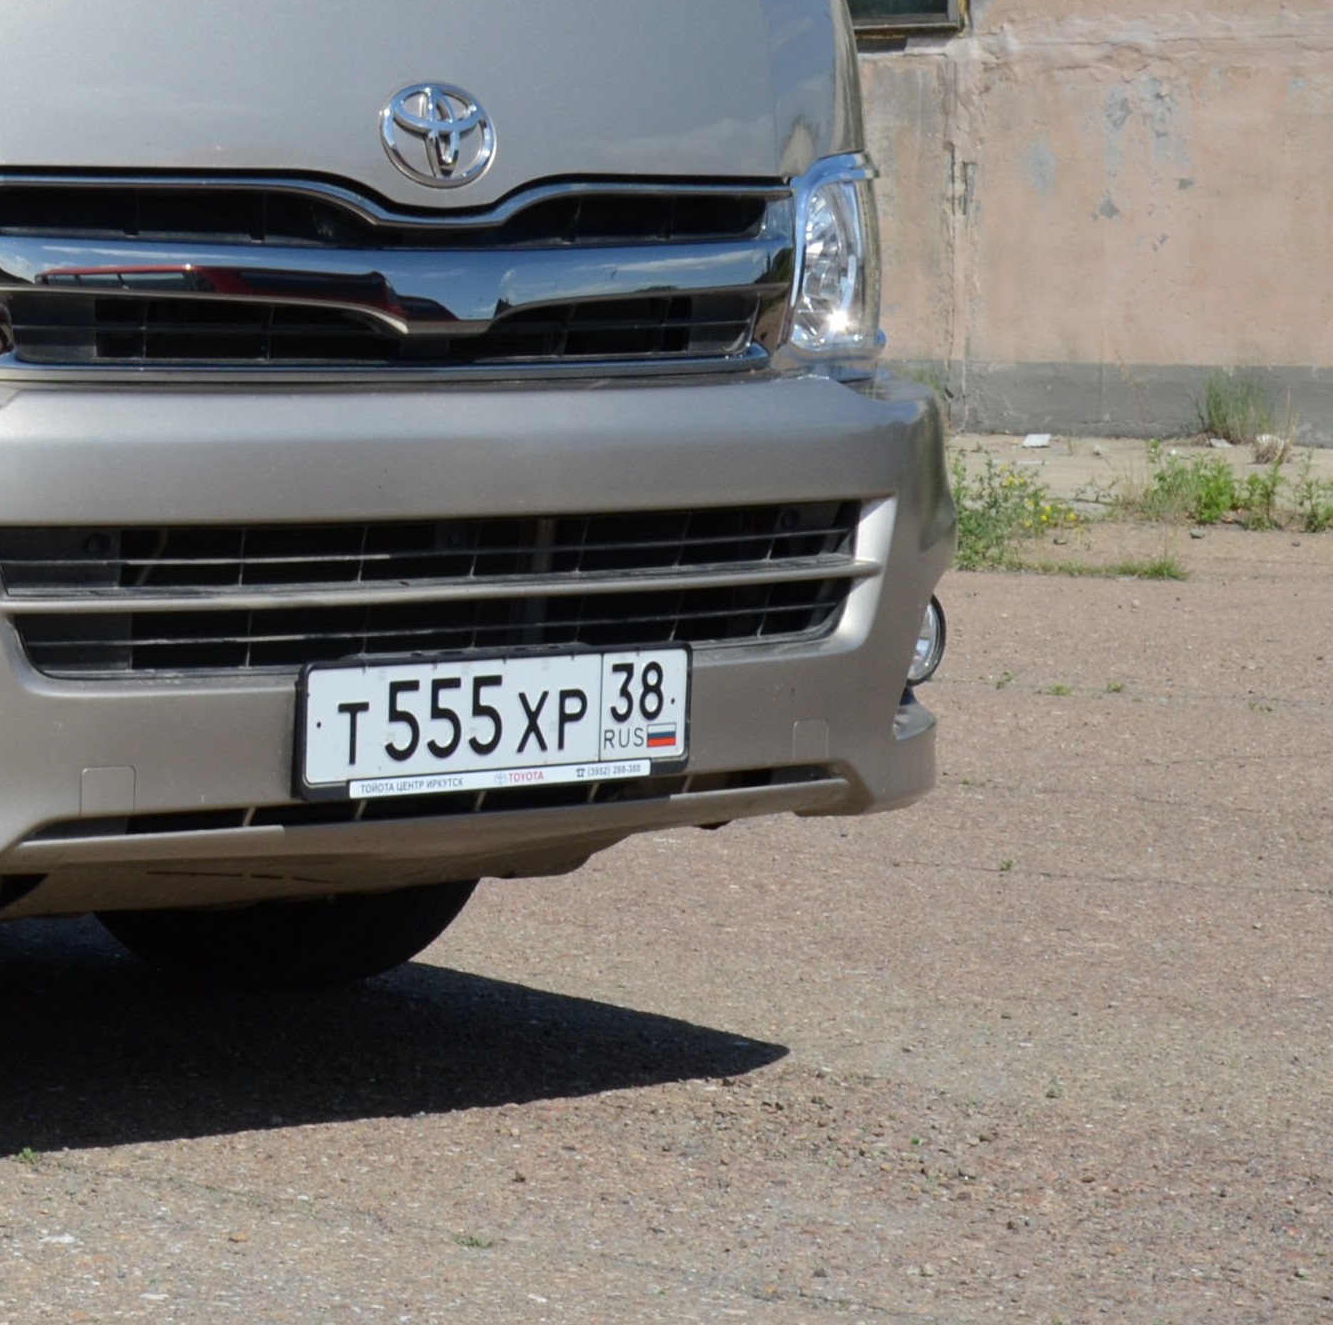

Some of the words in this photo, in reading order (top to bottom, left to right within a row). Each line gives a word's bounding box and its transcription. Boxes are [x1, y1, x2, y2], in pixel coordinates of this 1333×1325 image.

[609, 661, 665, 723] 38
[603, 727, 645, 751] RUS
[361, 782, 395, 794] ТОЙОТА
[396, 780, 424, 793] ЦЕНТР
[426, 777, 464, 789] ИРКУТСК
[509, 771, 545, 783] TOYOTA
